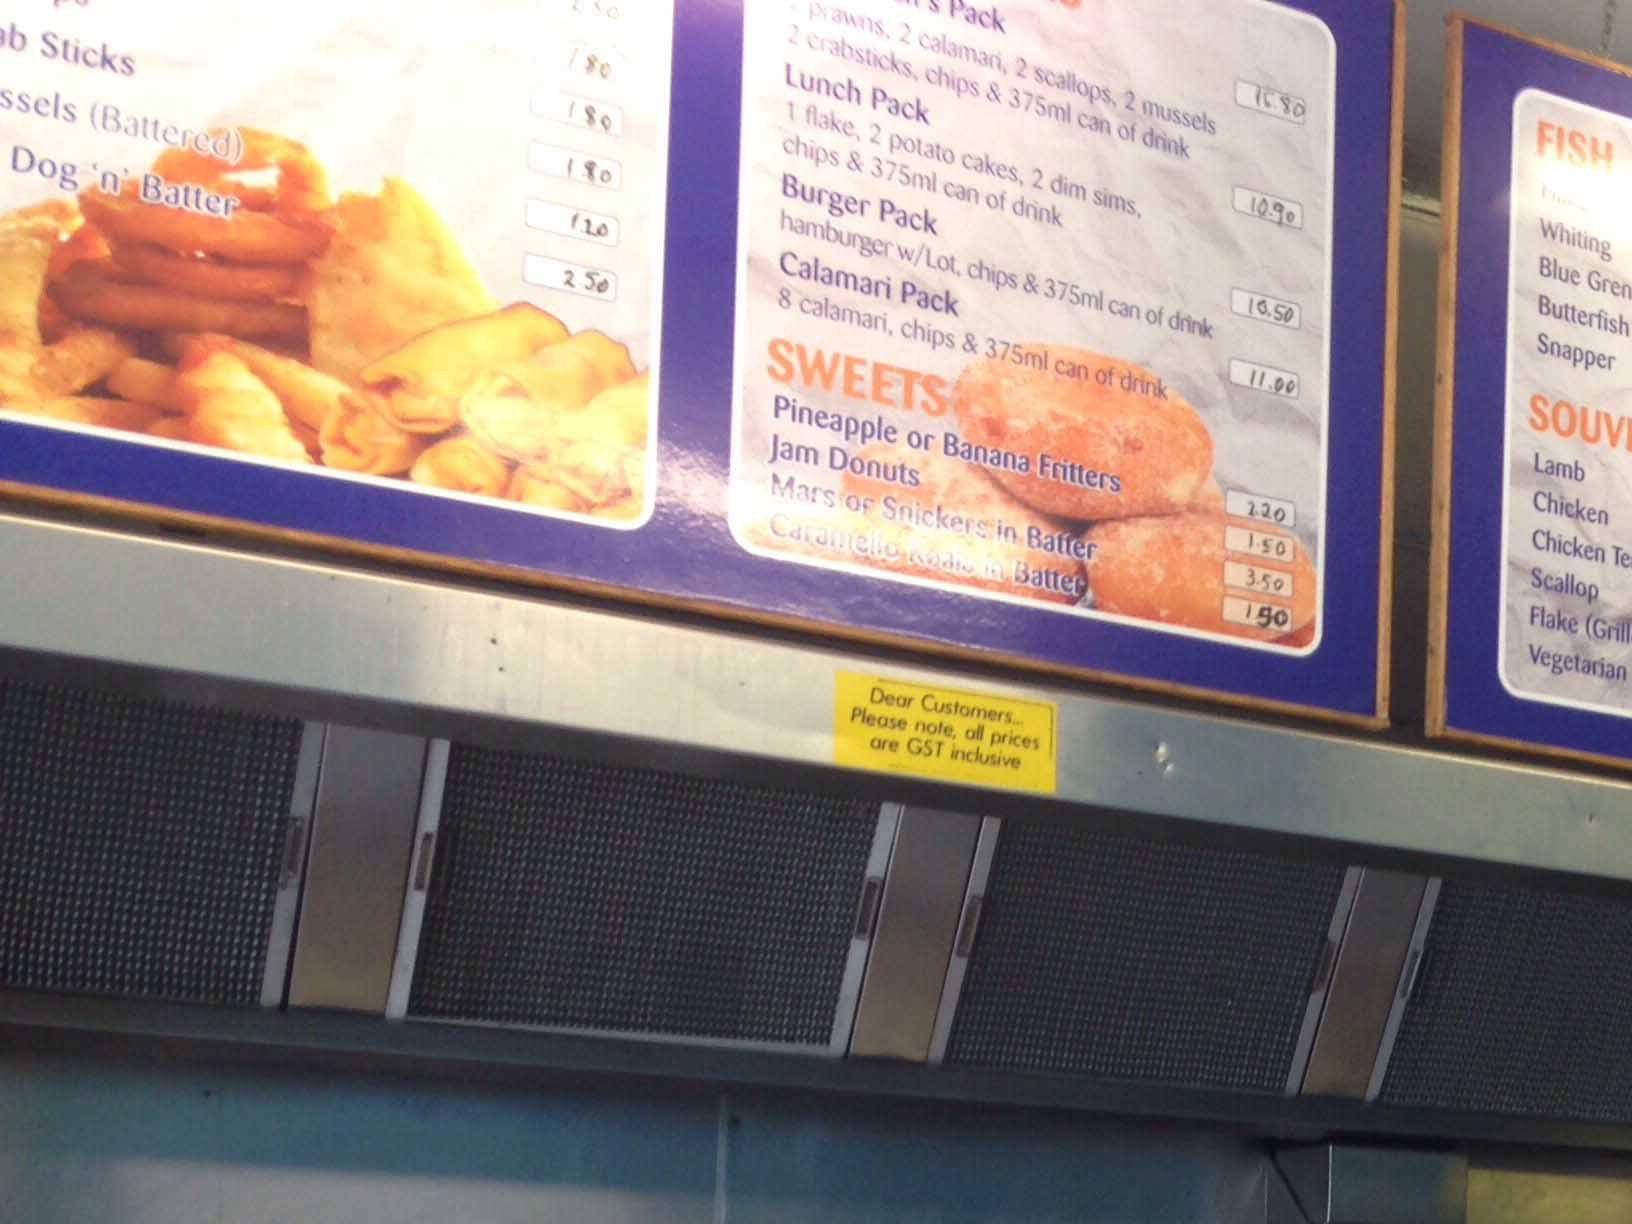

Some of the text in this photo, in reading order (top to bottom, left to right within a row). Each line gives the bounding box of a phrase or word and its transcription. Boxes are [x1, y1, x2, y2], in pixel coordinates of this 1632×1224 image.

[40, 31, 136, 77] Sticks
[785, 62, 931, 126] Lunch Pack
[807, 33, 1191, 160] crabsticks, chips 375ml can of drink
[1034, 65, 1118, 109] scallops,
[1141, 99, 1217, 136] mussels
[90, 102, 243, 162] (Battered)
[1537, 120, 1614, 175] FISH
[11, 145, 238, 217] Dog Batter
[782, 136, 1064, 228] chips 375ml can of drink
[805, 104, 1142, 218] flake, potato cakes, dim sims,
[782, 172, 939, 236] Burger Pack
[1539, 217, 1612, 262] Whiting
[779, 250, 961, 318] Calamari Pack
[780, 208, 895, 258] hamburger
[967, 259, 1019, 291] chips
[1043, 278, 1104, 312] 375ml
[1108, 299, 1141, 321] can
[1145, 306, 1164, 327] of
[1168, 311, 1214, 340] drink
[1539, 255, 1581, 286] Blue
[1538, 294, 1630, 337] Butterfish
[799, 297, 1169, 401] calamari, chips 375ml can of drink
[1537, 333, 1615, 372] Snapper
[767, 337, 948, 417] SWEETS
[768, 433, 921, 487] Jam Donuts
[773, 394, 1122, 493] Pineapple or Banana Fritters
[1534, 453, 1585, 483] Lamb
[771, 472, 1098, 561] Mars or Snickers in Batter
[1533, 492, 1609, 526] Chicken
[1532, 530, 1605, 564] Chicken
[1015, 560, 1088, 595] Batter
[1531, 568, 1599, 601] Scallop
[1530, 606, 1578, 634] Flake
[1529, 644, 1627, 682] Vegetarian
[870, 687, 914, 708] Dear
[851, 706, 1040, 750] Please note, all prices
[870, 737, 1022, 769] are GST inclusive
